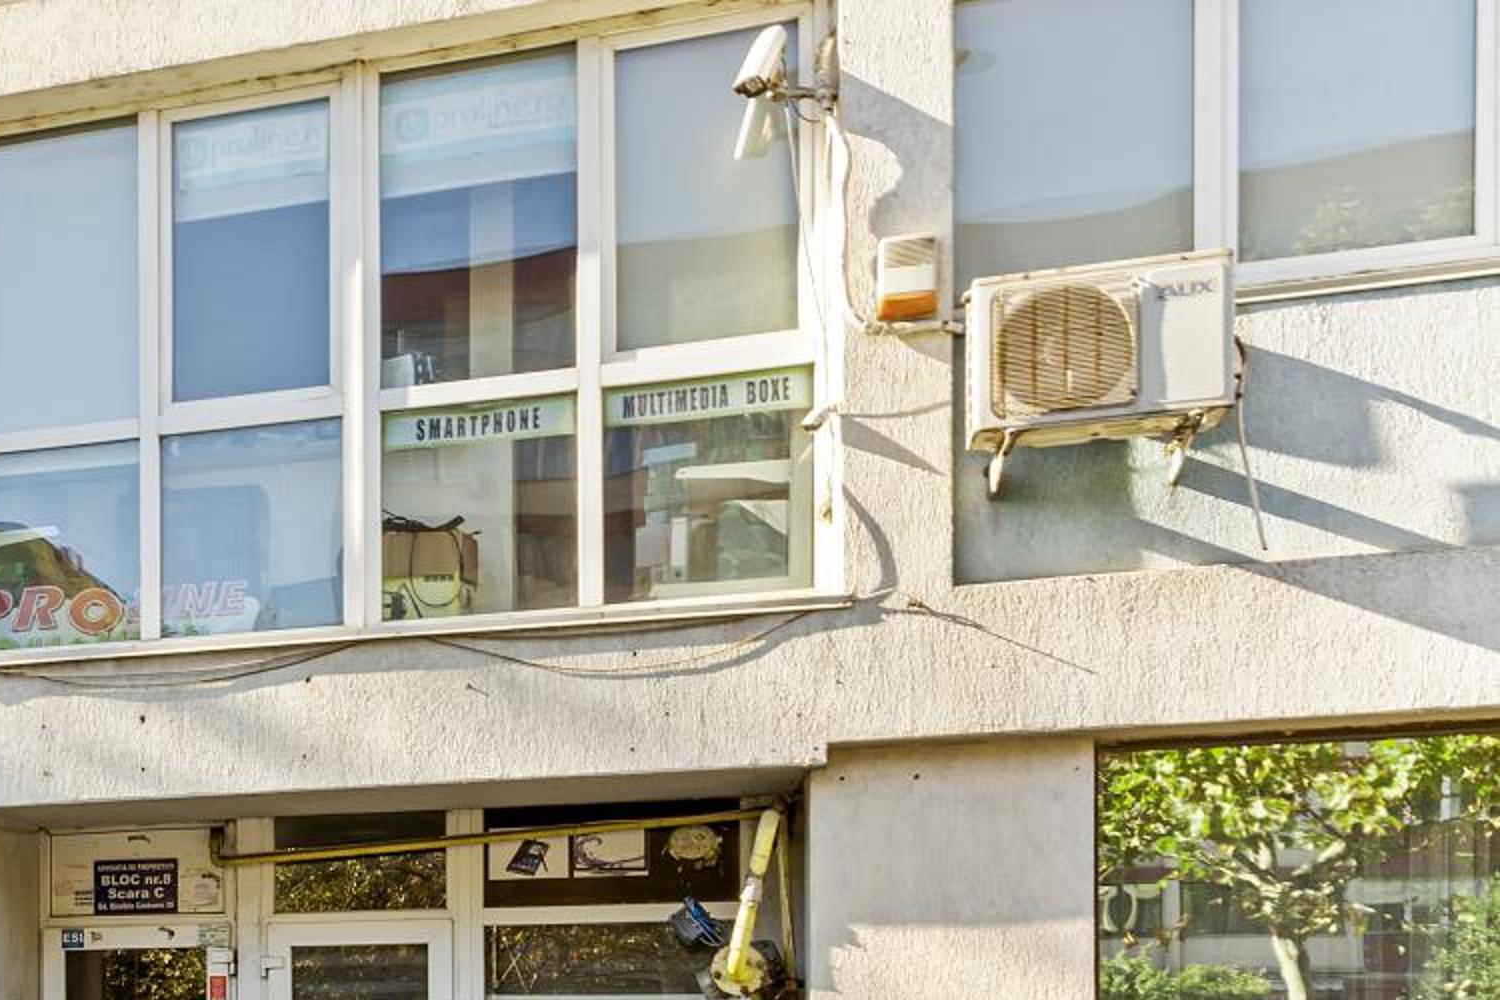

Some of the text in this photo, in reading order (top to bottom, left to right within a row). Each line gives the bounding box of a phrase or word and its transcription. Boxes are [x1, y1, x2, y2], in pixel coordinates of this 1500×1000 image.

[622, 376, 791, 419] MULTIMEDIA BOXE
[415, 407, 541, 441] SMARTPHONE
[100, 873, 141, 887] BLOC
[107, 886, 165, 899] Scara C
